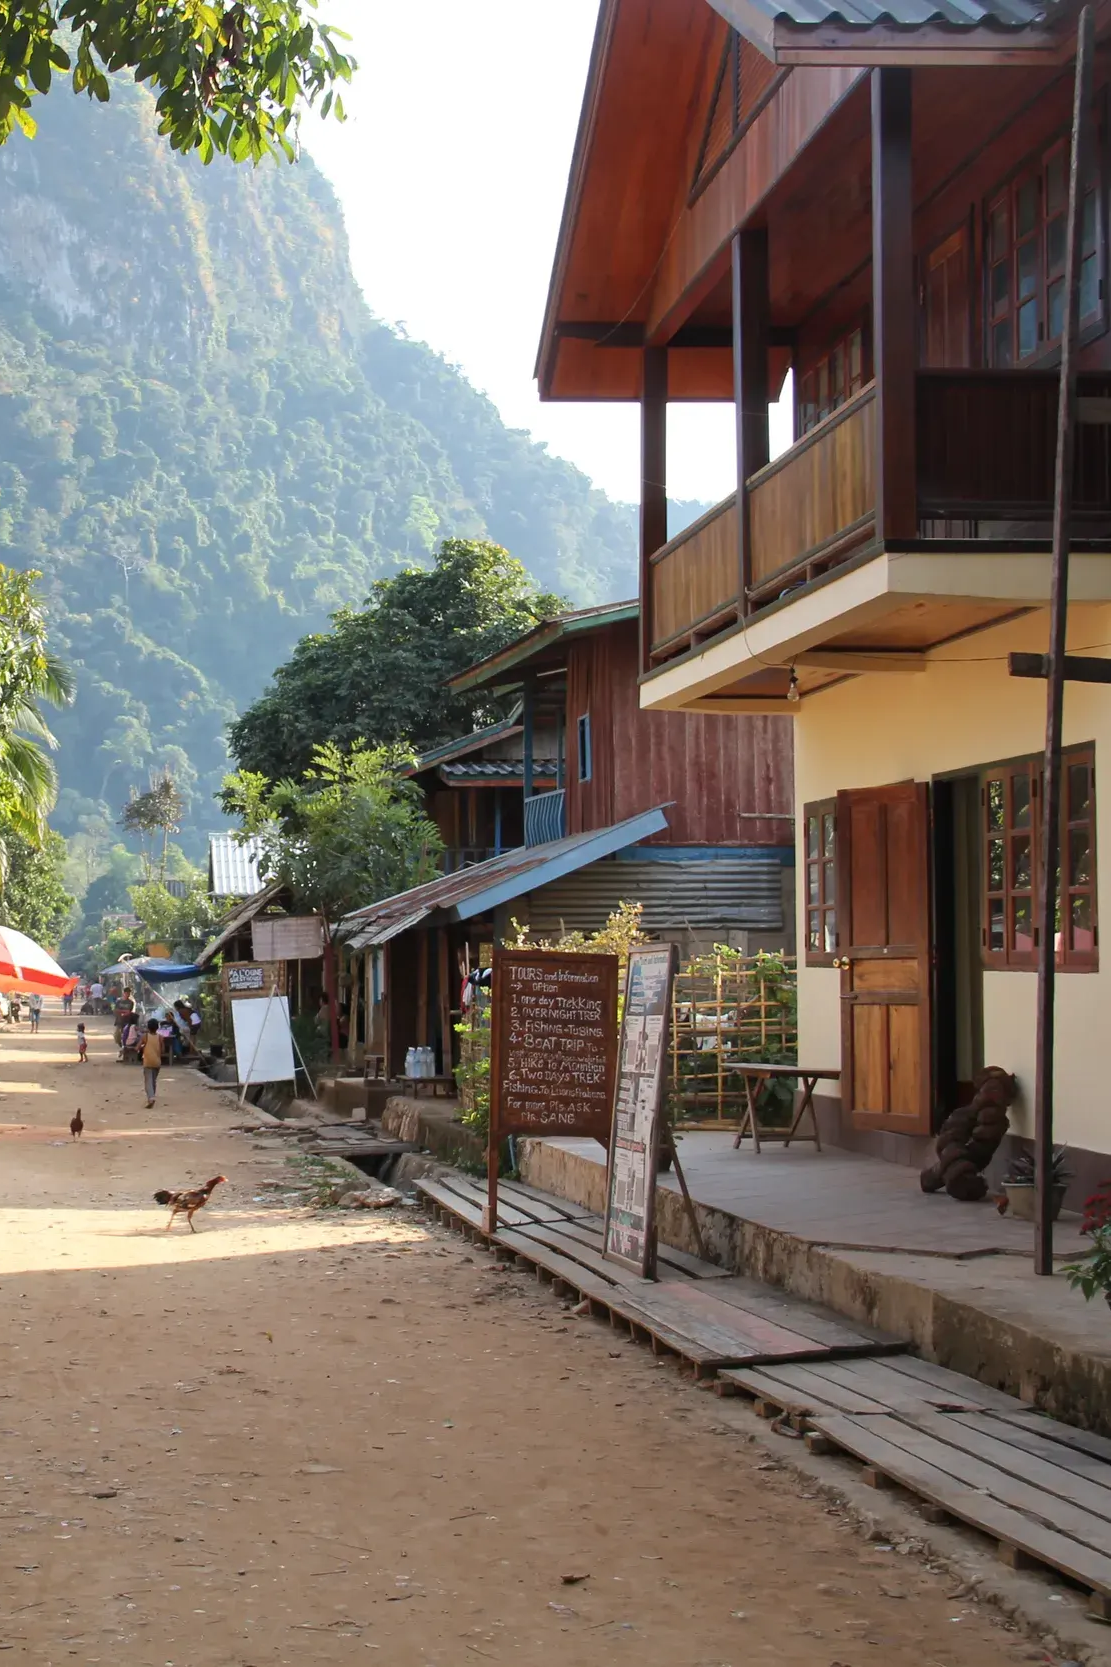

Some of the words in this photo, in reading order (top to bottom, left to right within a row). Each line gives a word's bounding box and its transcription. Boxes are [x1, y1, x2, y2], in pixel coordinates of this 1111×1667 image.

[509, 966, 543, 981] TOURS
[544, 971, 557, 981] and
[521, 995, 537, 1005] one
[539, 995, 555, 1008] day
[510, 1007, 520, 1017] 2.
[578, 1010, 601, 1020] TREK
[511, 1020, 523, 1031] 3.
[507, 1096, 522, 1109] For
[540, 1111, 575, 1125] SANG
